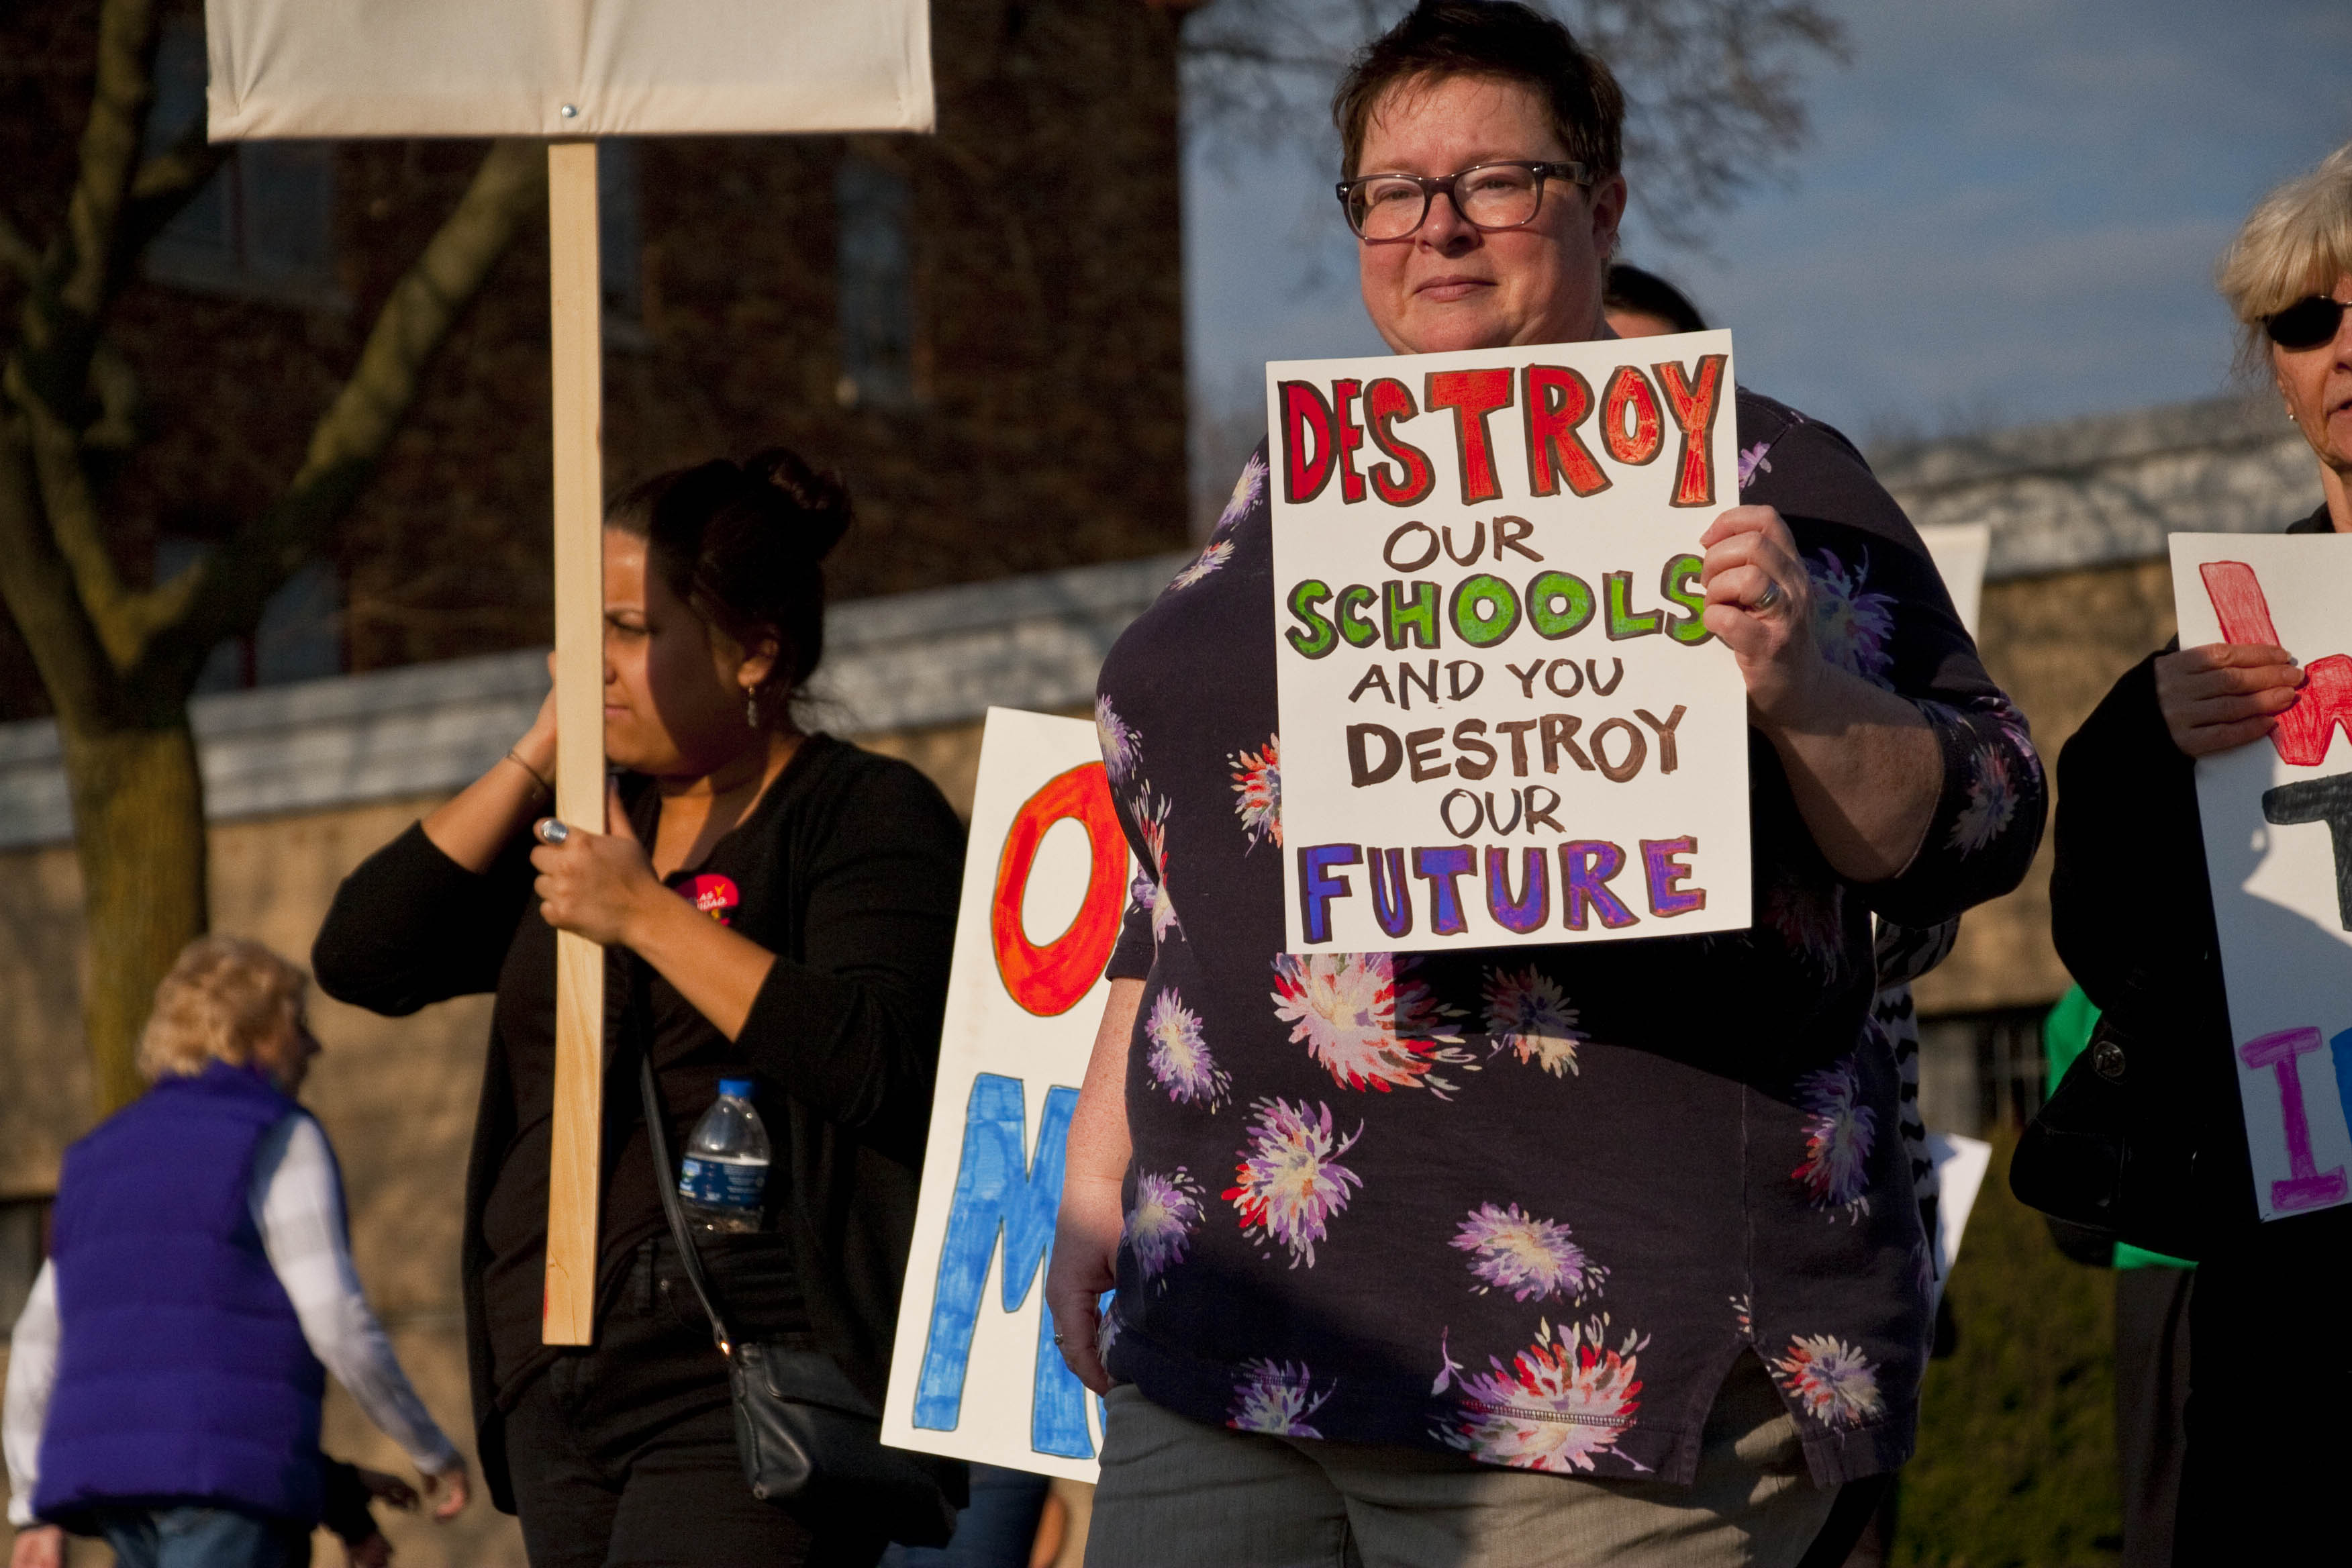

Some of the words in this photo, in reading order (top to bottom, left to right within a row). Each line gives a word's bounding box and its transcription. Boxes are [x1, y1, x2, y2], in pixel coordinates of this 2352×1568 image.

[1277, 354, 1728, 507] DESTROY
[1383, 515, 1544, 573] OUR
[1285, 553, 1716, 659] SCHOOLS
[1348, 658, 1484, 709] AND
[1506, 657, 1624, 699] YOU
[1346, 705, 1687, 788] DESTROY
[1440, 785, 1567, 839] OUR
[1297, 835, 1706, 944] FUTURE
